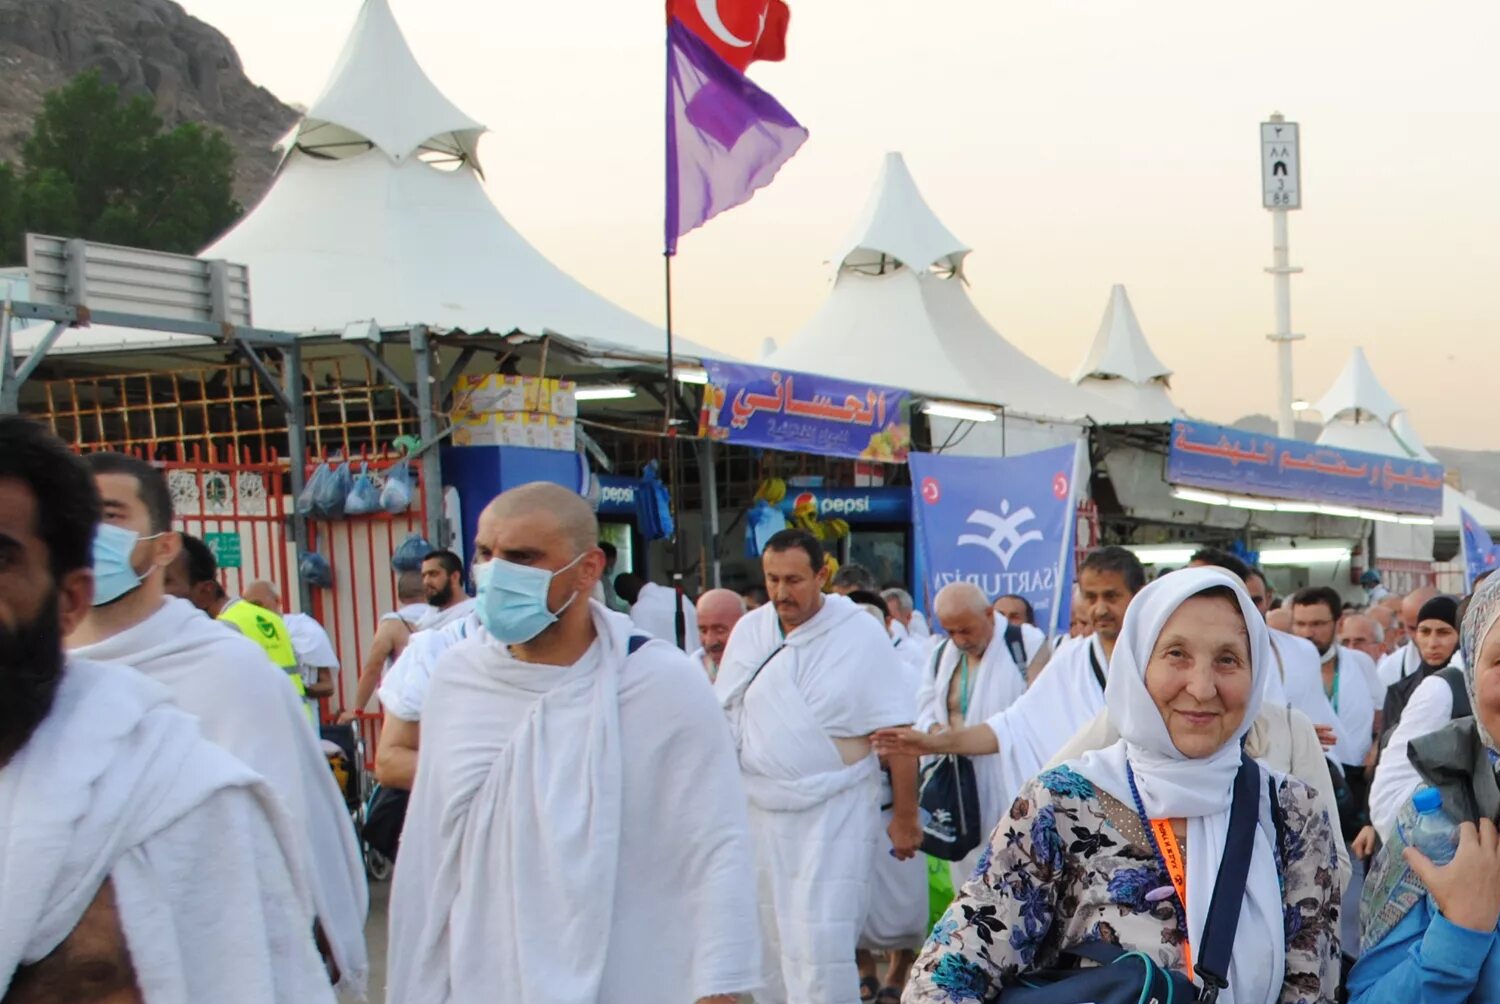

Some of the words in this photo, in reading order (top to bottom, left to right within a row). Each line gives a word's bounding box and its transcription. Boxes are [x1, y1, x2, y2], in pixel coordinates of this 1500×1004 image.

[731, 372, 886, 429] الحساني
[602, 486, 635, 506] pepsi
[820, 496, 870, 515] pepsi
